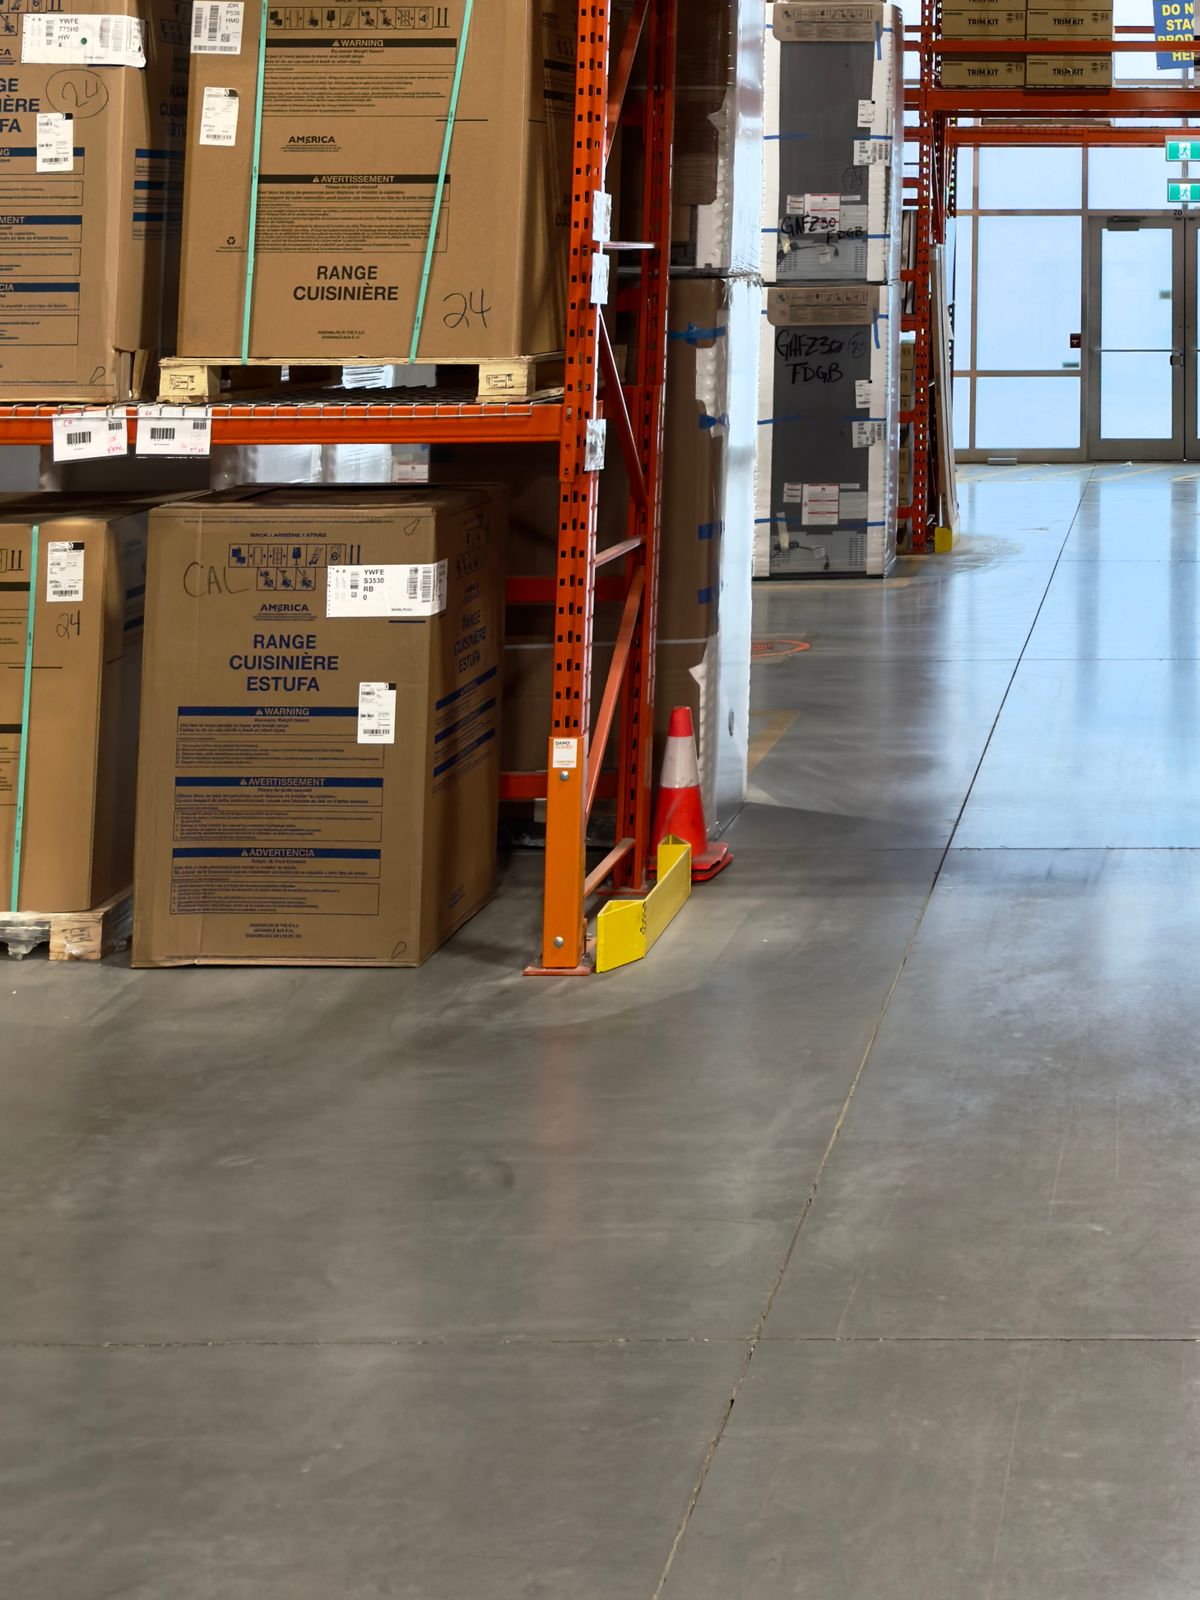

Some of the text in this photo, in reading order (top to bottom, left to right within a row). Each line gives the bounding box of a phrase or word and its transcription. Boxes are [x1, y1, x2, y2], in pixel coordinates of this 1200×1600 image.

[1162, 4, 1181, 16] DO
[986, 68, 999, 76] KIT
[1053, 68, 1084, 76] TRIM KIT
[288, 136, 335, 144] AMERICA
[321, 175, 395, 184] AVERTISSEMENT
[316, 266, 377, 280] RANGE
[293, 283, 398, 301] CUISINIÈRE
[443, 288, 491, 329] 24
[785, 362, 843, 385] FDGB
[260, 604, 309, 612] AMERICA
[56, 609, 82, 640] 24
[253, 634, 316, 649] RANGE
[229, 652, 338, 671] CUISINIÈRE
[246, 676, 320, 692] ESTUFA
[265, 708, 309, 716] WARNING
[249, 778, 325, 786] AVERTISSEMENT
[250, 849, 315, 857] ADVERTENCIA
